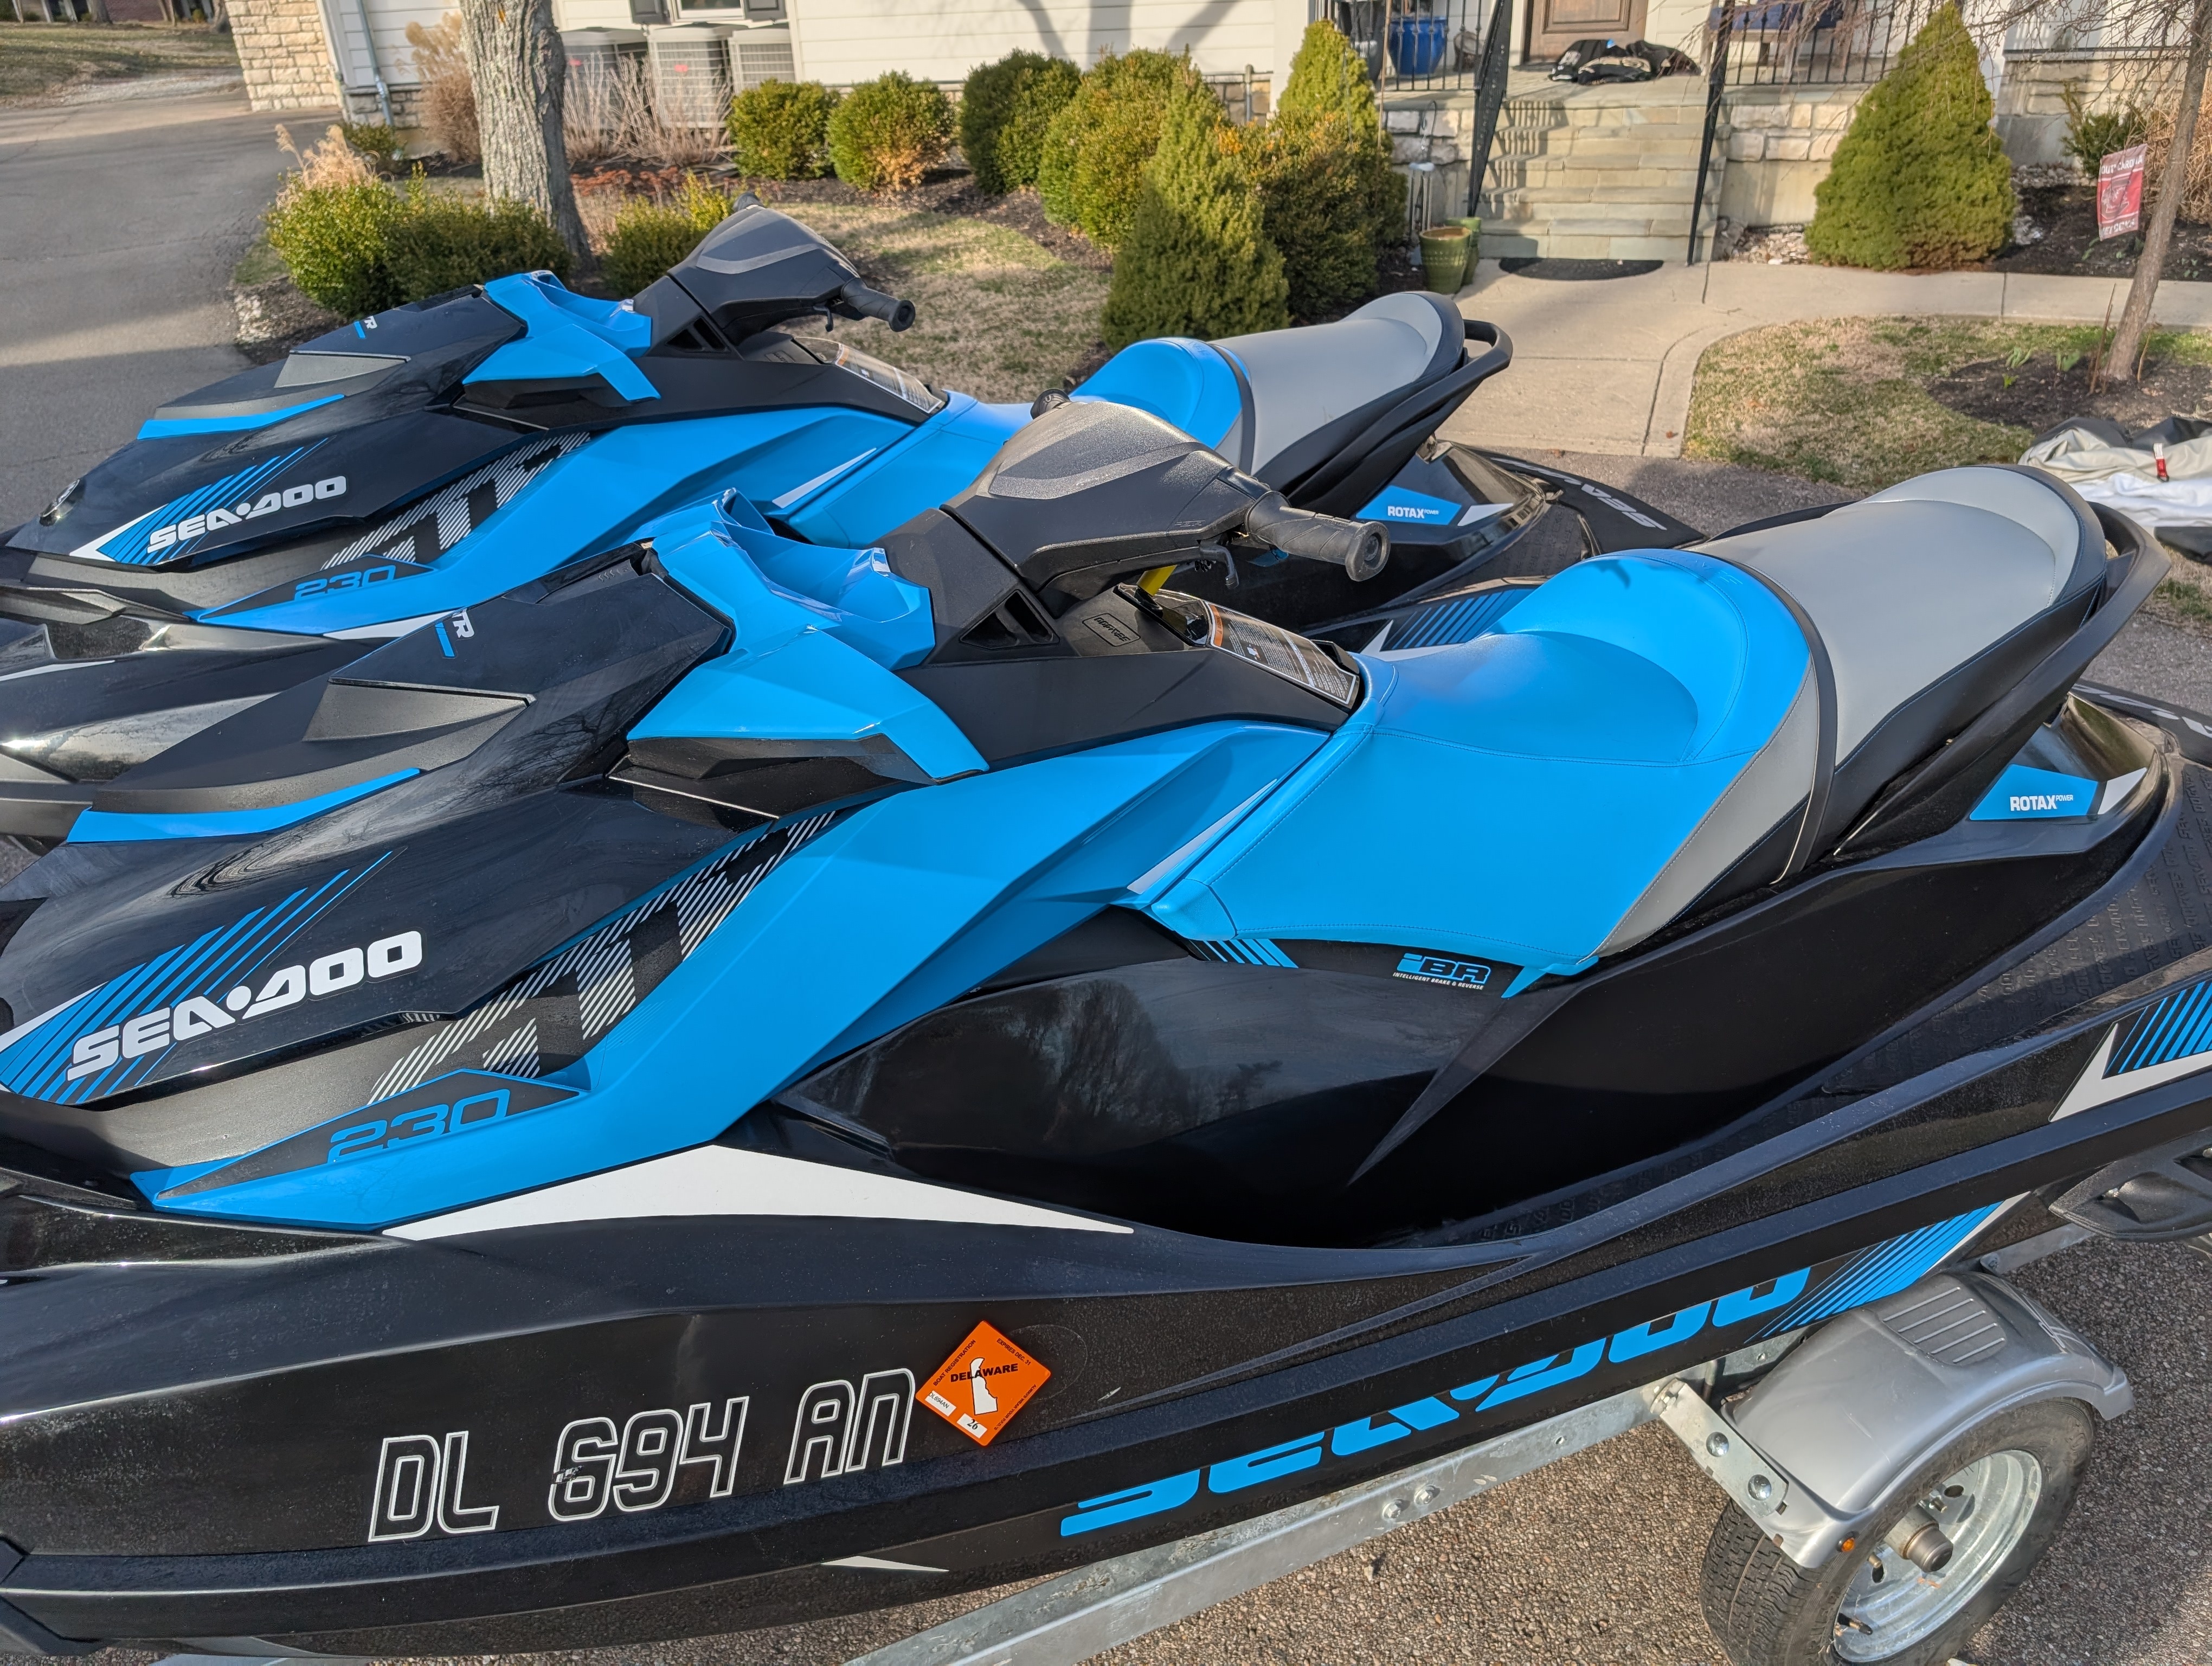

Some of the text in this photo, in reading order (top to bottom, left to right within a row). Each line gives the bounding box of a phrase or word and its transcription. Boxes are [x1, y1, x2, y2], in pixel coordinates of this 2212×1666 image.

[2099, 164, 2117, 175] OUT
[1387, 505, 1425, 519] ROTAX
[294, 565, 396, 601] 230
[2010, 794, 2057, 811] ROTAX
[1392, 972, 1431, 982] INTELLIGENT
[1457, 982, 1485, 990] REVERSE
[326, 1088, 510, 1163] 230
[996, 1338, 1015, 1354] EXPIRES
[1014, 1351, 1026, 1362] DEC.
[933, 1339, 976, 1386] BOAT REGISTRATION
[950, 1363, 1019, 1382] DELAWARE
[928, 1391, 950, 1409] DL694AN
[1024, 1384, 1037, 1399] ALWAYS
[1014, 1398, 1025, 1409] WEAR
[1004, 1408, 1015, 1420] YOUR
[966, 1419, 980, 1431] 26
[368, 1367, 916, 1541] DL 694 AN
